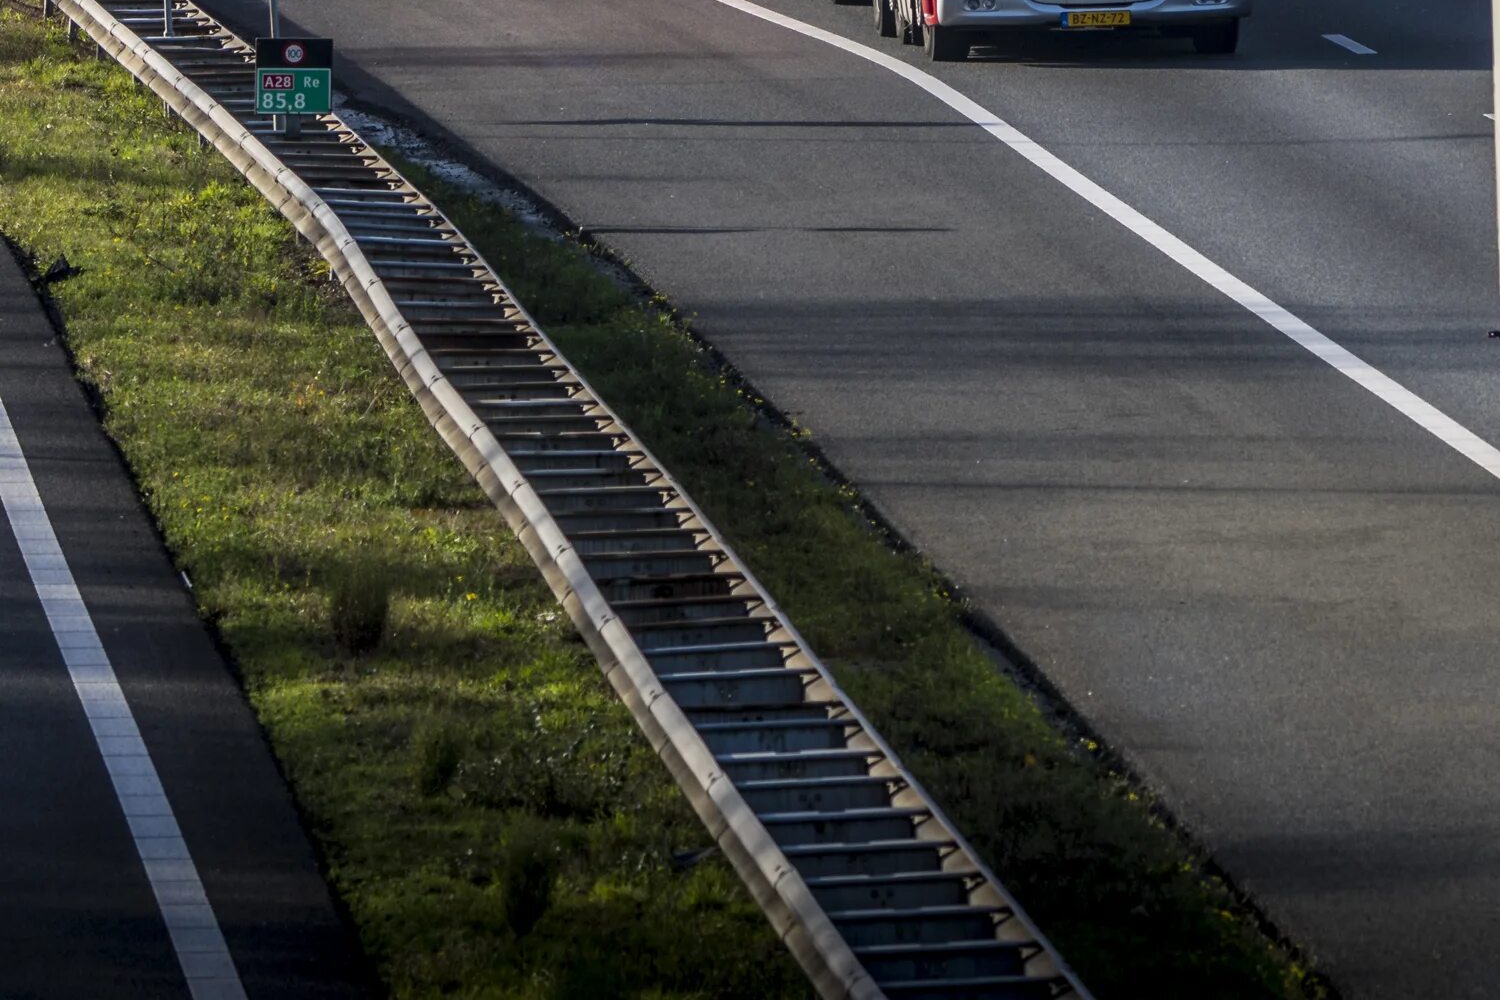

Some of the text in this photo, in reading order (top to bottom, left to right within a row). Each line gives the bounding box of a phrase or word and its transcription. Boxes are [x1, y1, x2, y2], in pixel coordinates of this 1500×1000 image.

[1072, 12, 1125, 25] BZ-NZ-72
[264, 76, 320, 88] A28 Re
[262, 92, 306, 111] 85,8
